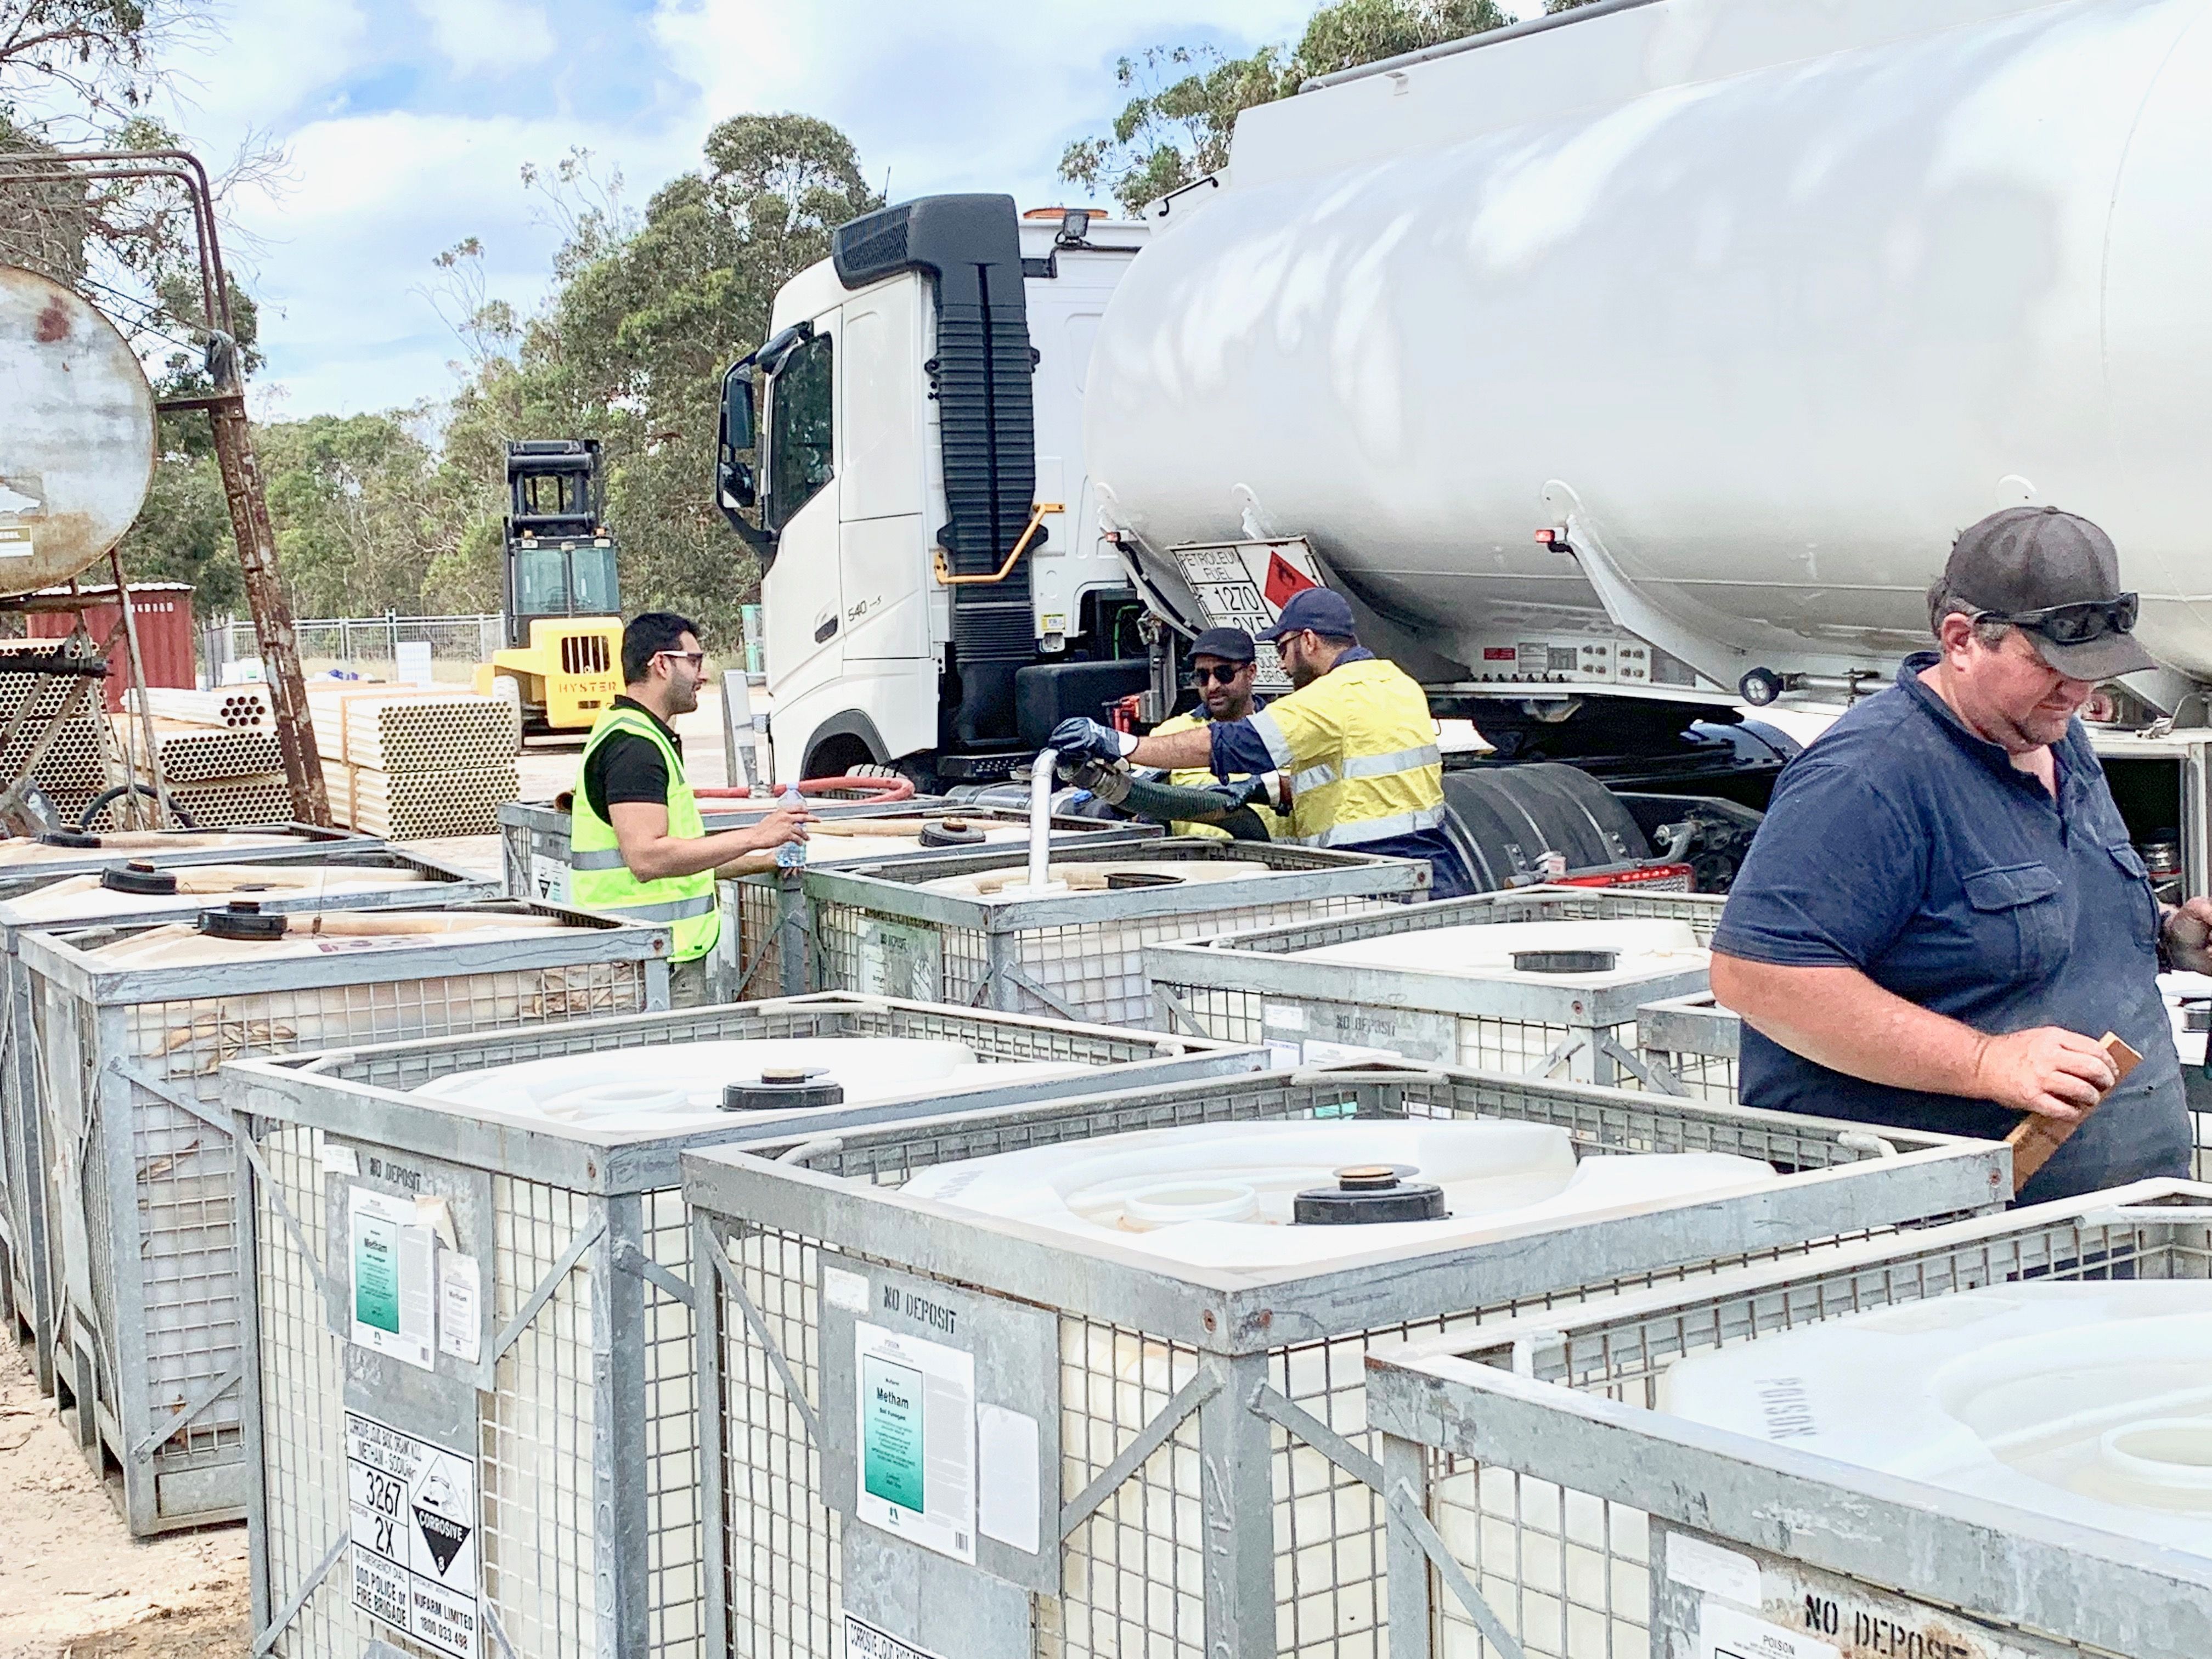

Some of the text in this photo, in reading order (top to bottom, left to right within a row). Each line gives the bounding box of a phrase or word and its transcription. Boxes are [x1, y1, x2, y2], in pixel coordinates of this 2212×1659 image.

[1203, 567, 1233, 580] FUEL
[848, 600, 867, 622] 540
[1214, 586, 1259, 611] 1270
[559, 681, 617, 693] HYSTER
[370, 1157, 422, 1192] NO DEPOSIT
[884, 1284, 957, 1334] NO DEPOSIT
[877, 1387, 909, 1409] Metham
[366, 1471, 401, 1517] 3267
[375, 1516, 394, 1558] 2X
[419, 1510, 463, 1542] CORROSIVE
[371, 1572, 396, 1601] POLICE
[357, 1585, 407, 1627] FIRE BRIGADE
[444, 1605, 473, 1631] LIMITED
[1805, 1594, 1838, 1636] NO
[1763, 1635, 1795, 1655] POISON
